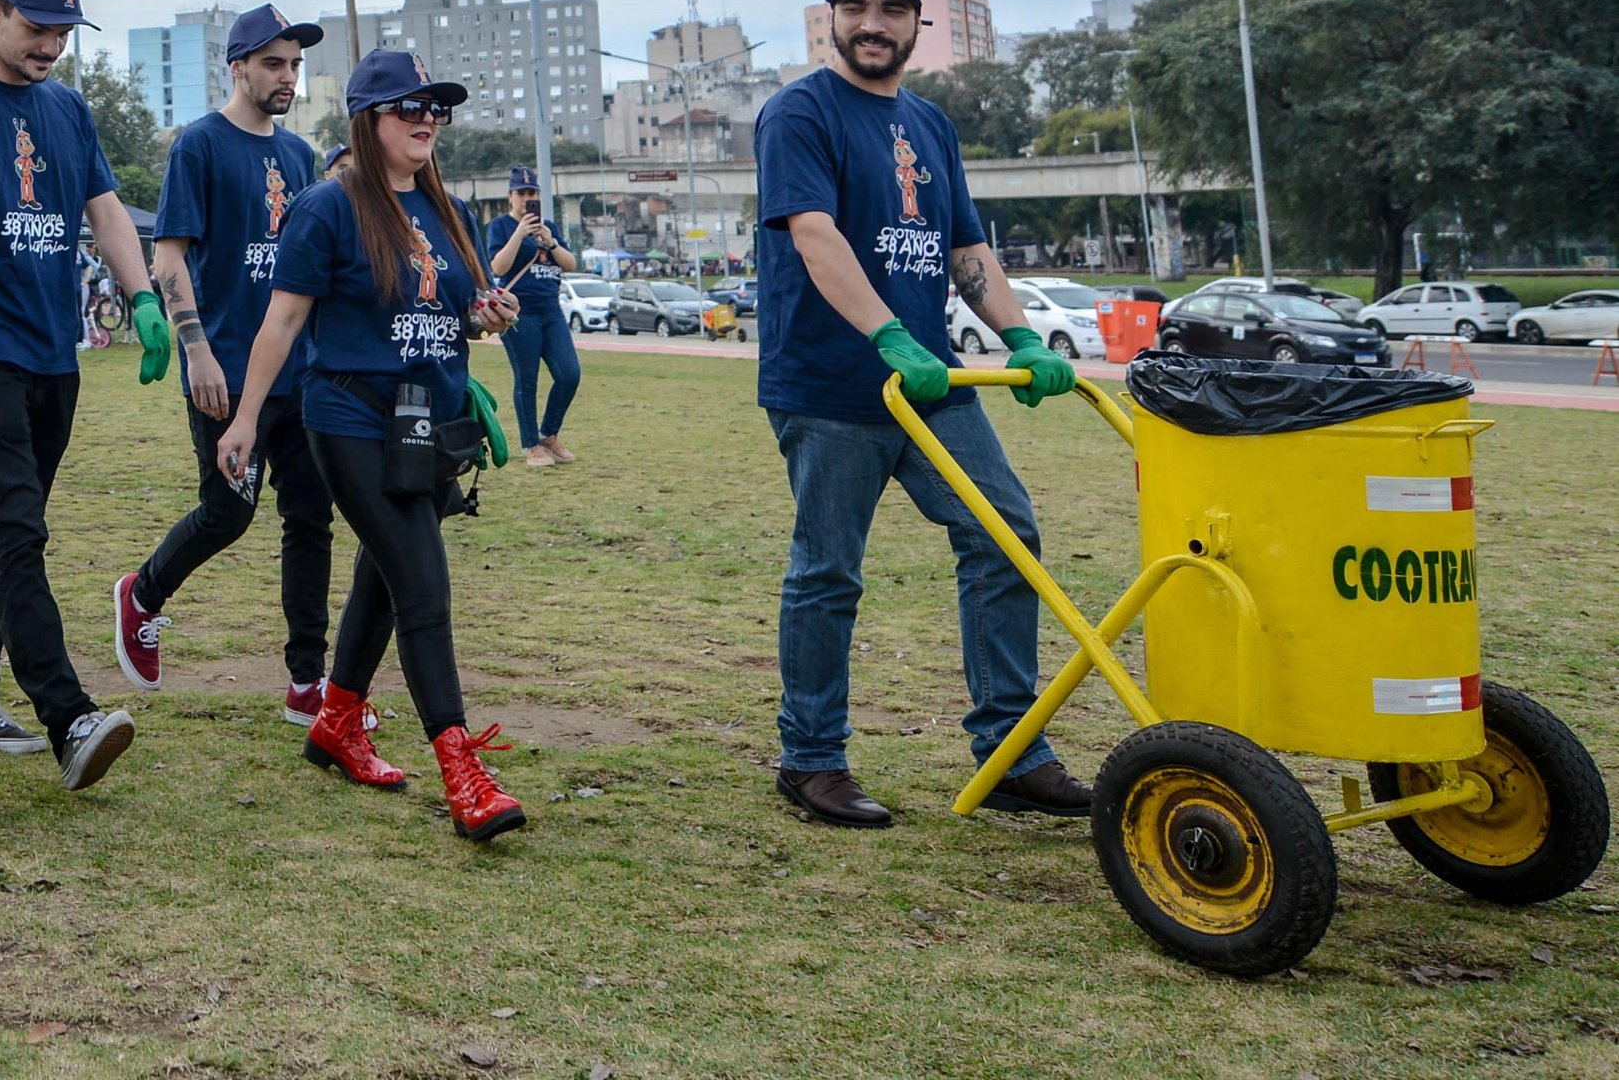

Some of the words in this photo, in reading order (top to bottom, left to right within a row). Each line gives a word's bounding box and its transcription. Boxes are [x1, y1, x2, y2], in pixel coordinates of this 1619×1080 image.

[6, 211, 64, 224] COOTRAVIPA
[1, 220, 22, 236] 38
[23, 222, 66, 237] ANOS
[880, 226, 941, 241] COOTRAVIP
[10, 233, 27, 256] de
[873, 235, 898, 253] 38
[898, 239, 943, 257] ANO
[244, 250, 264, 265] 38
[884, 251, 901, 276] de
[250, 262, 267, 283] de
[390, 322, 415, 340] 38
[416, 323, 458, 341] ANOS
[394, 313, 460, 331] COOTRAVIPA
[400, 339, 420, 362] de
